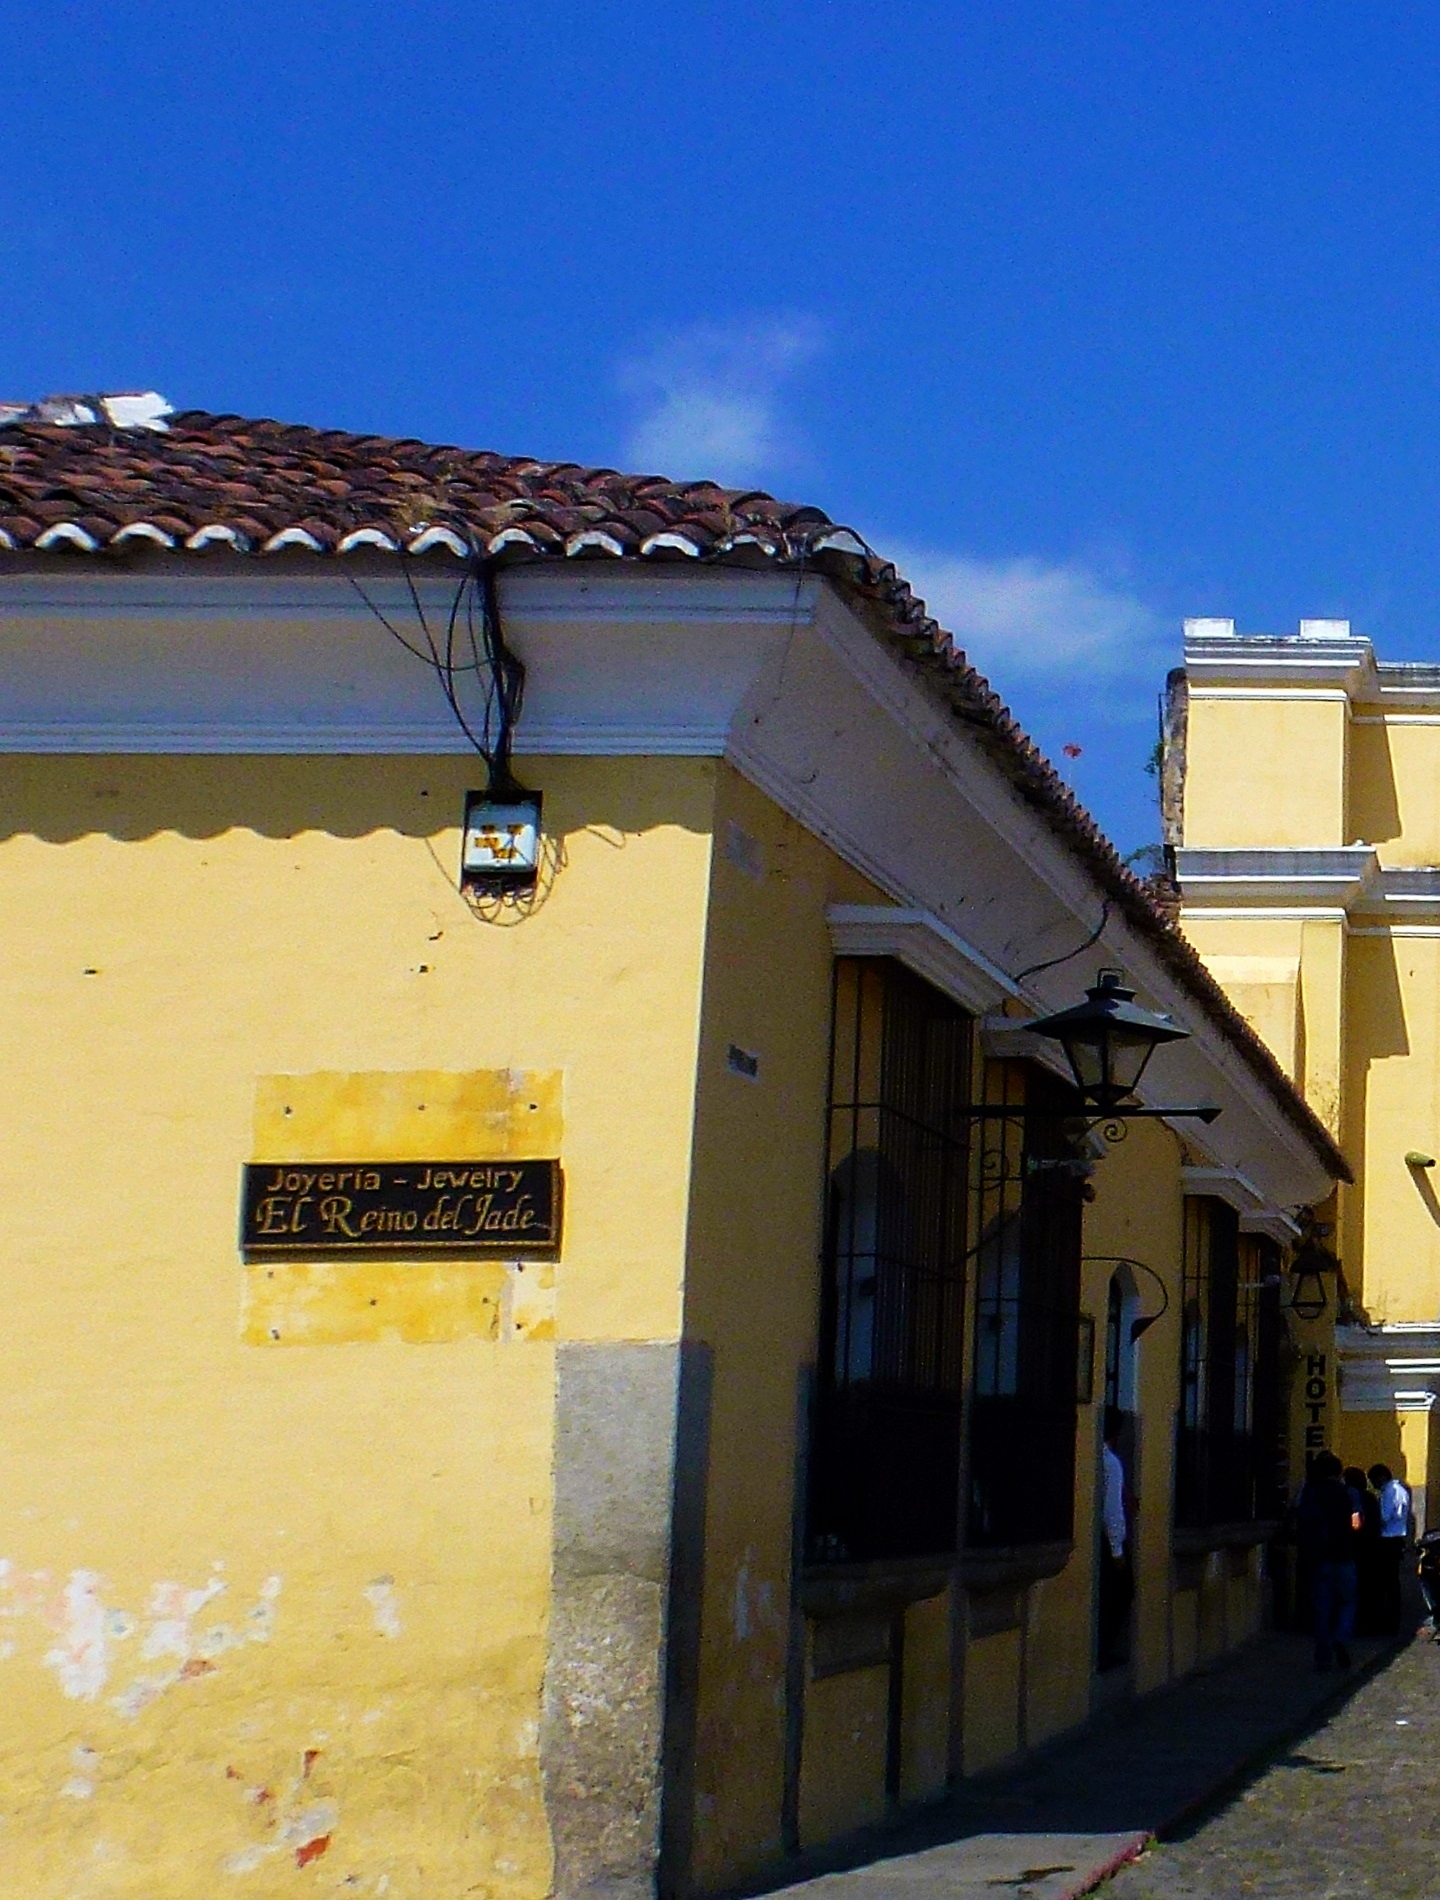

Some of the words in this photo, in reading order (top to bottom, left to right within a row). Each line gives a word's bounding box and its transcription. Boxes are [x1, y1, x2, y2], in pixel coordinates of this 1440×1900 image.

[416, 1167, 524, 1193] Jewelry
[256, 1196, 315, 1235] El
[319, 1196, 418, 1238] Reino
[423, 1194, 474, 1231] del
[464, 1193, 546, 1236] Jade
